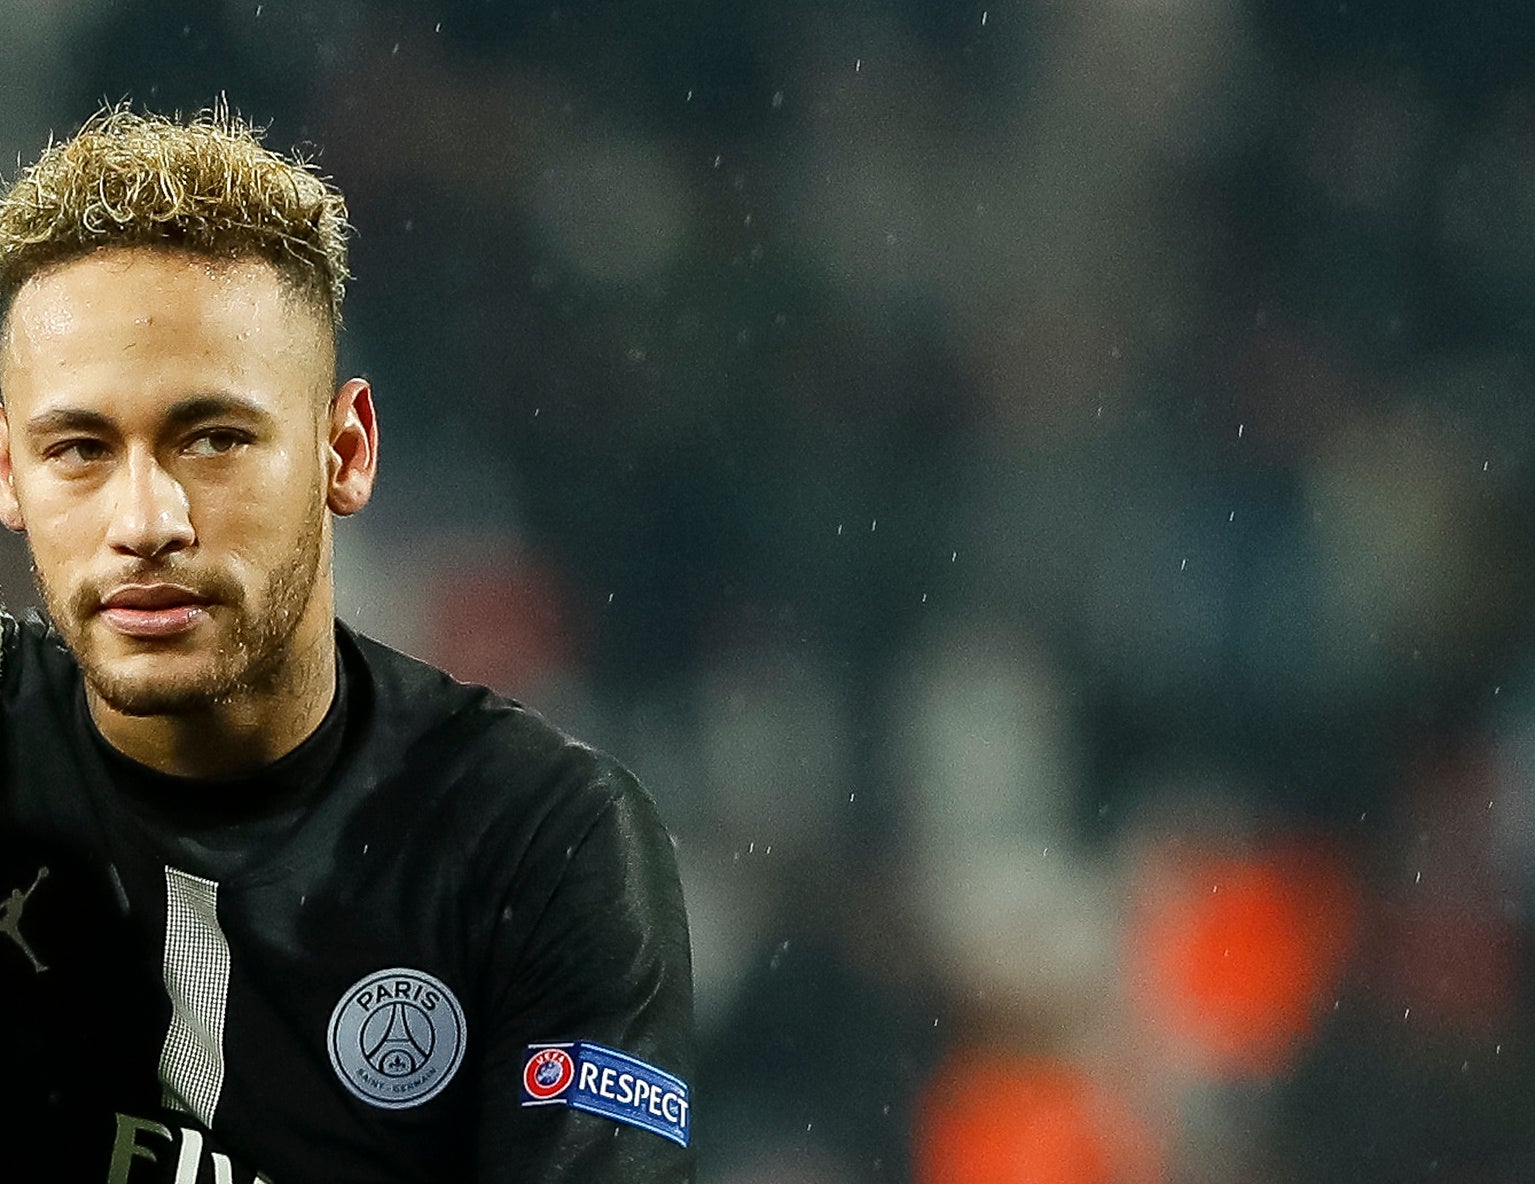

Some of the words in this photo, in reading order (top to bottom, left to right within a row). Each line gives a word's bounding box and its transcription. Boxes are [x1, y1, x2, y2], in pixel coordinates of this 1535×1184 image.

[355, 980, 440, 1012] PARIS
[535, 1051, 566, 1066] UEFA
[578, 1061, 689, 1129] RESPECT
